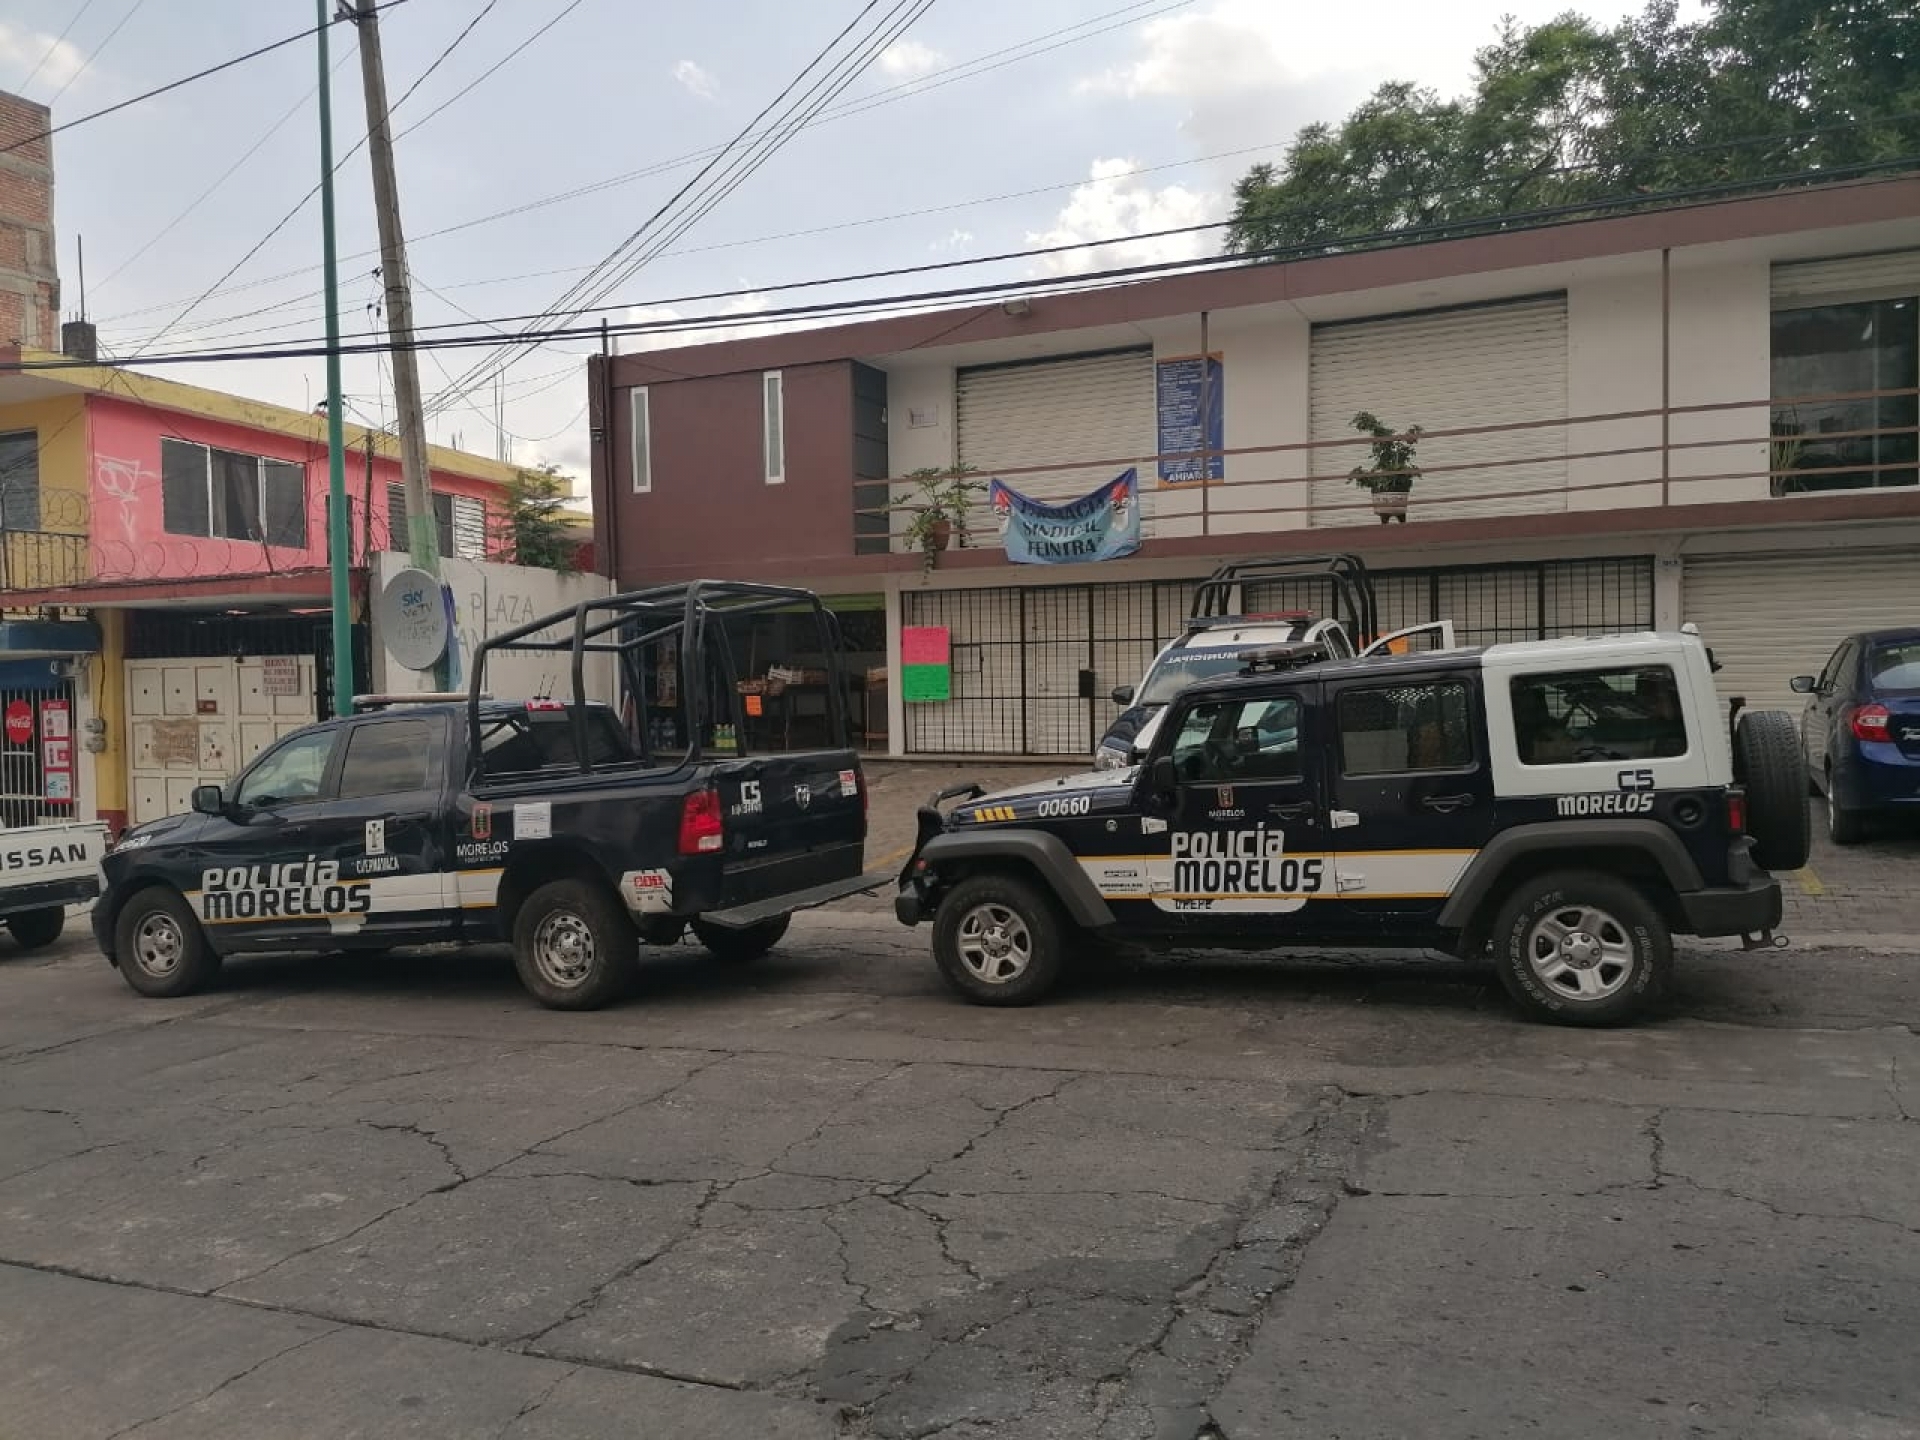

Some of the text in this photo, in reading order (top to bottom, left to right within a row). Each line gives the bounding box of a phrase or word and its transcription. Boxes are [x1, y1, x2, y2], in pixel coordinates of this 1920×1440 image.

[1168, 470, 1213, 482] AMPARS
[1038, 796, 1090, 817] 00660
[1208, 809, 1245, 817] MORELOS
[1556, 793, 1655, 816] MORELOS
[457, 840, 510, 857] MORELOS
[1174, 859, 1323, 893] MORELOS
[203, 883, 371, 920] MORELOS
